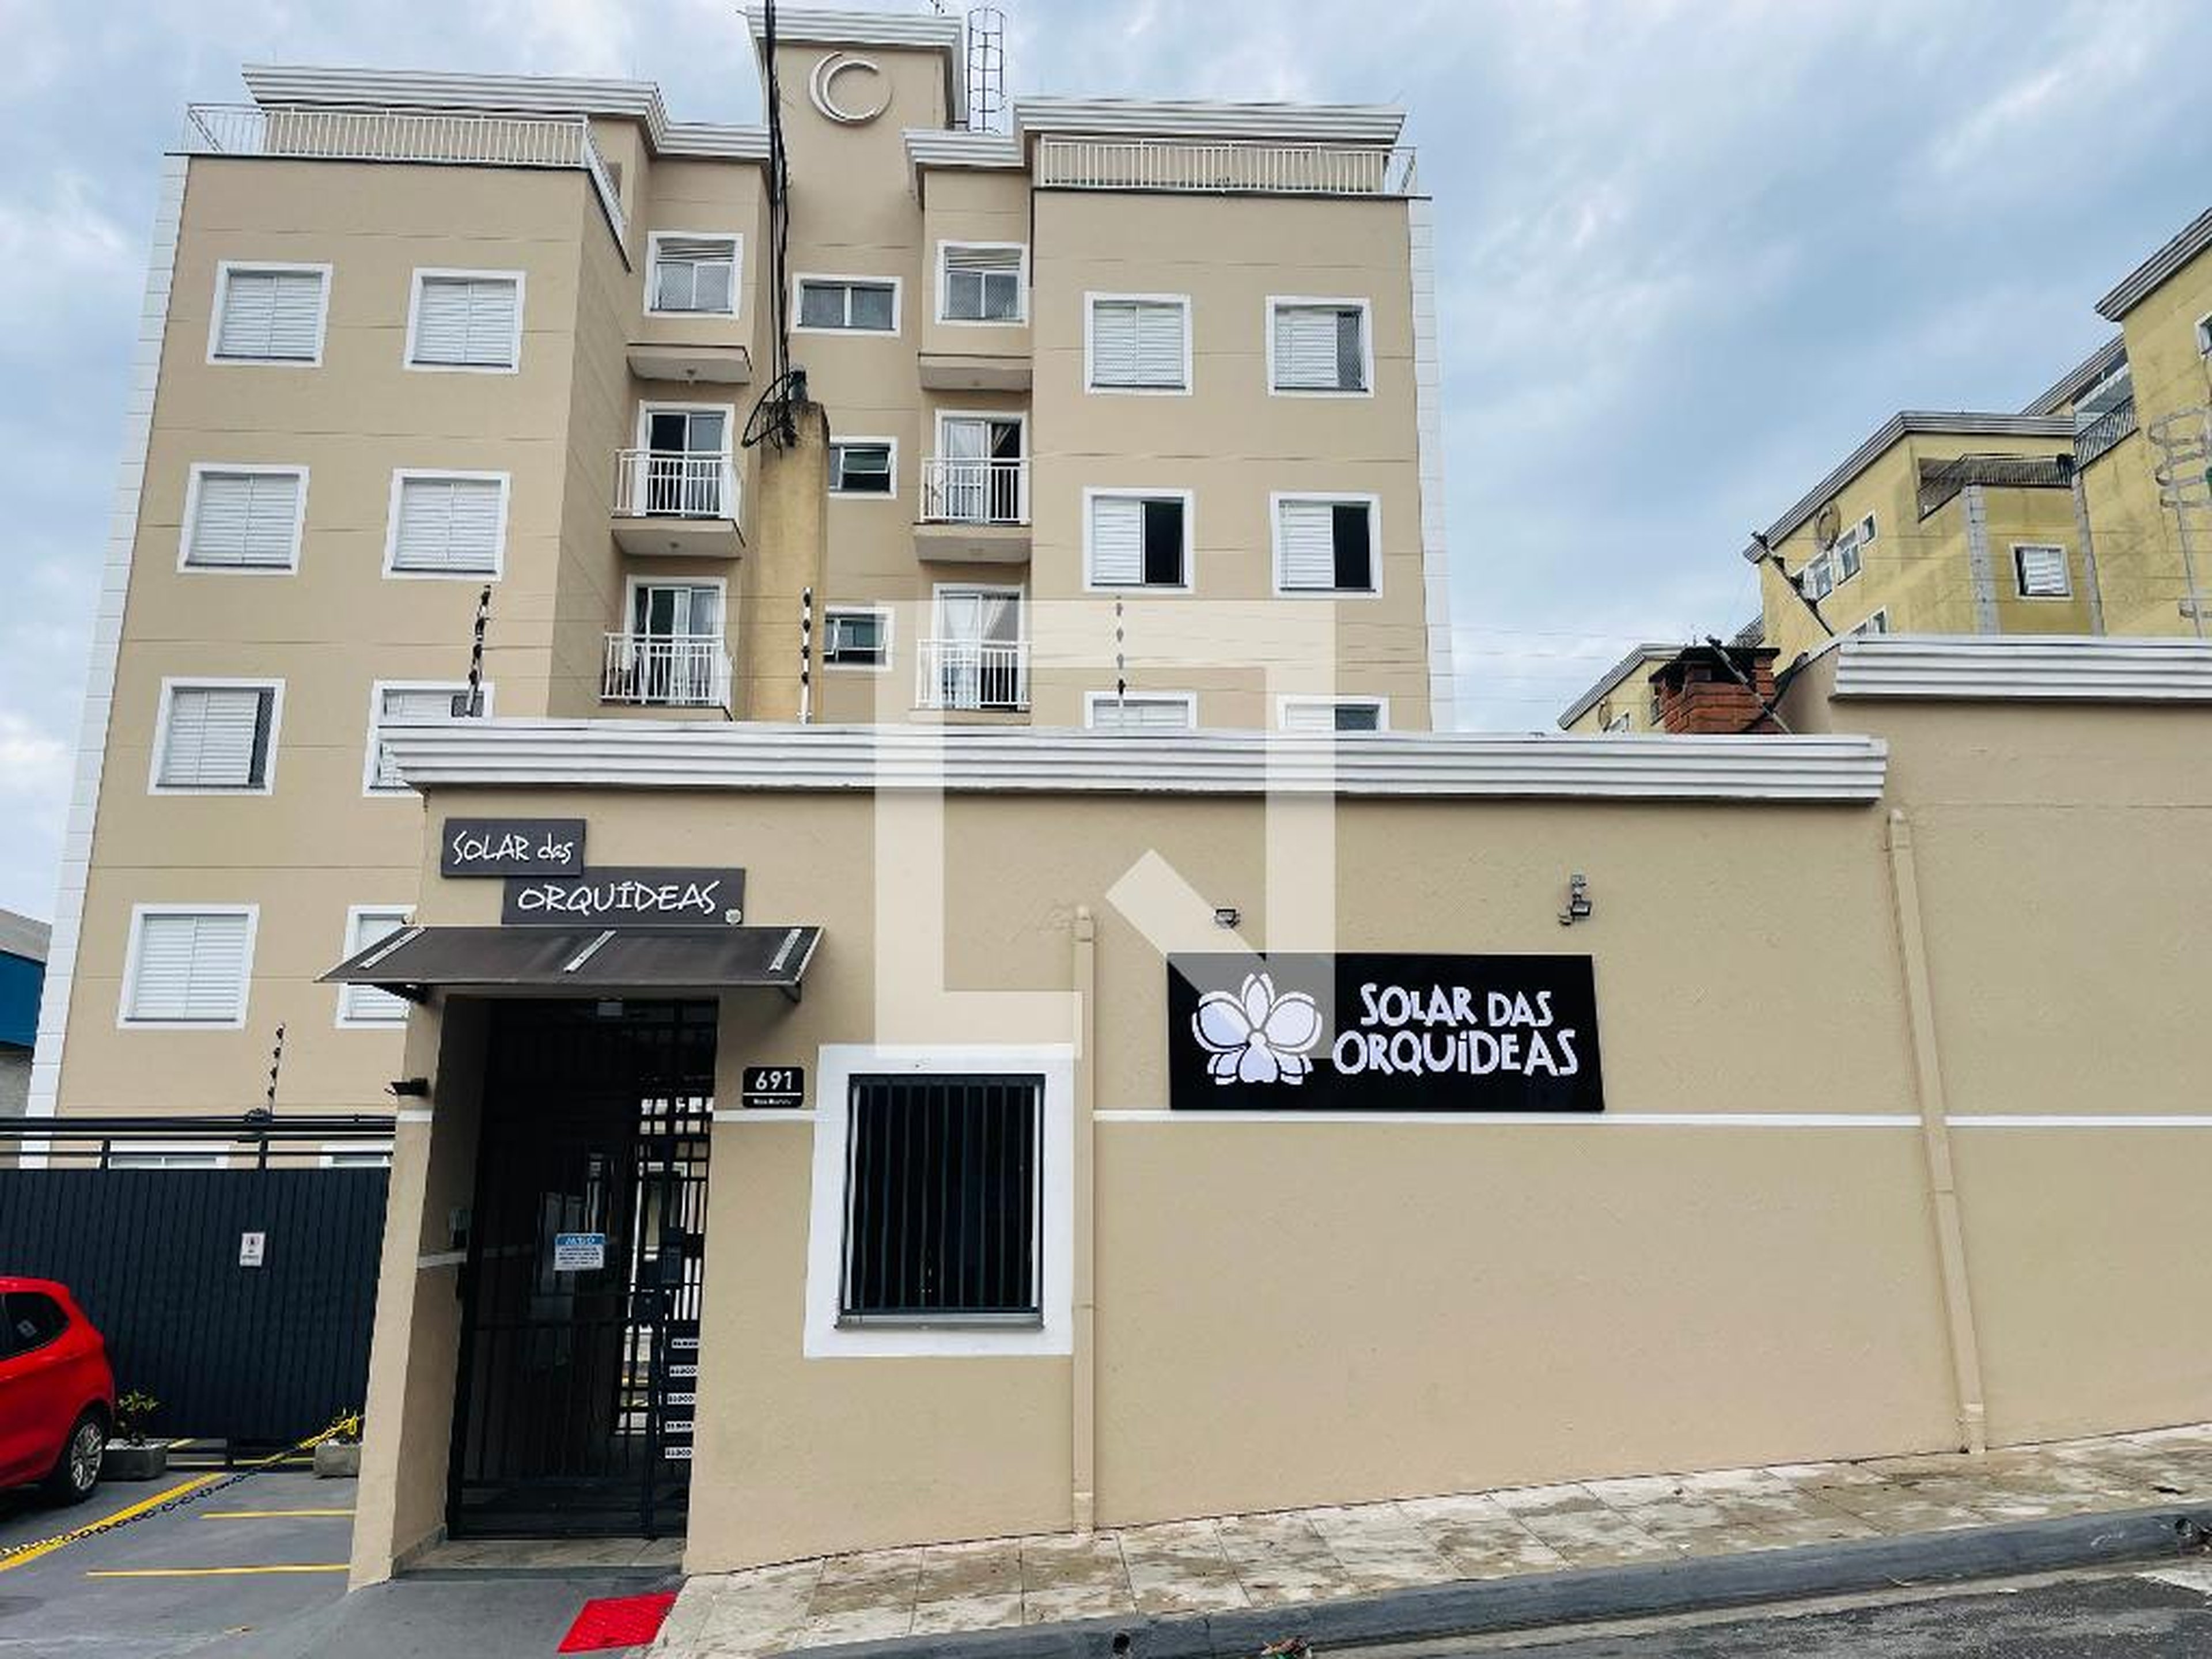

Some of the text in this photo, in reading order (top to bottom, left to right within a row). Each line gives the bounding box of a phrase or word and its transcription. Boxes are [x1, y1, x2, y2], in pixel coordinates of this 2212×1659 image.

[453, 830, 529, 865] SOLAR
[518, 881, 721, 915] ORQUÍDEAS
[1360, 983, 1554, 1027] SOLAR DAS
[755, 1071, 791, 1090] 691
